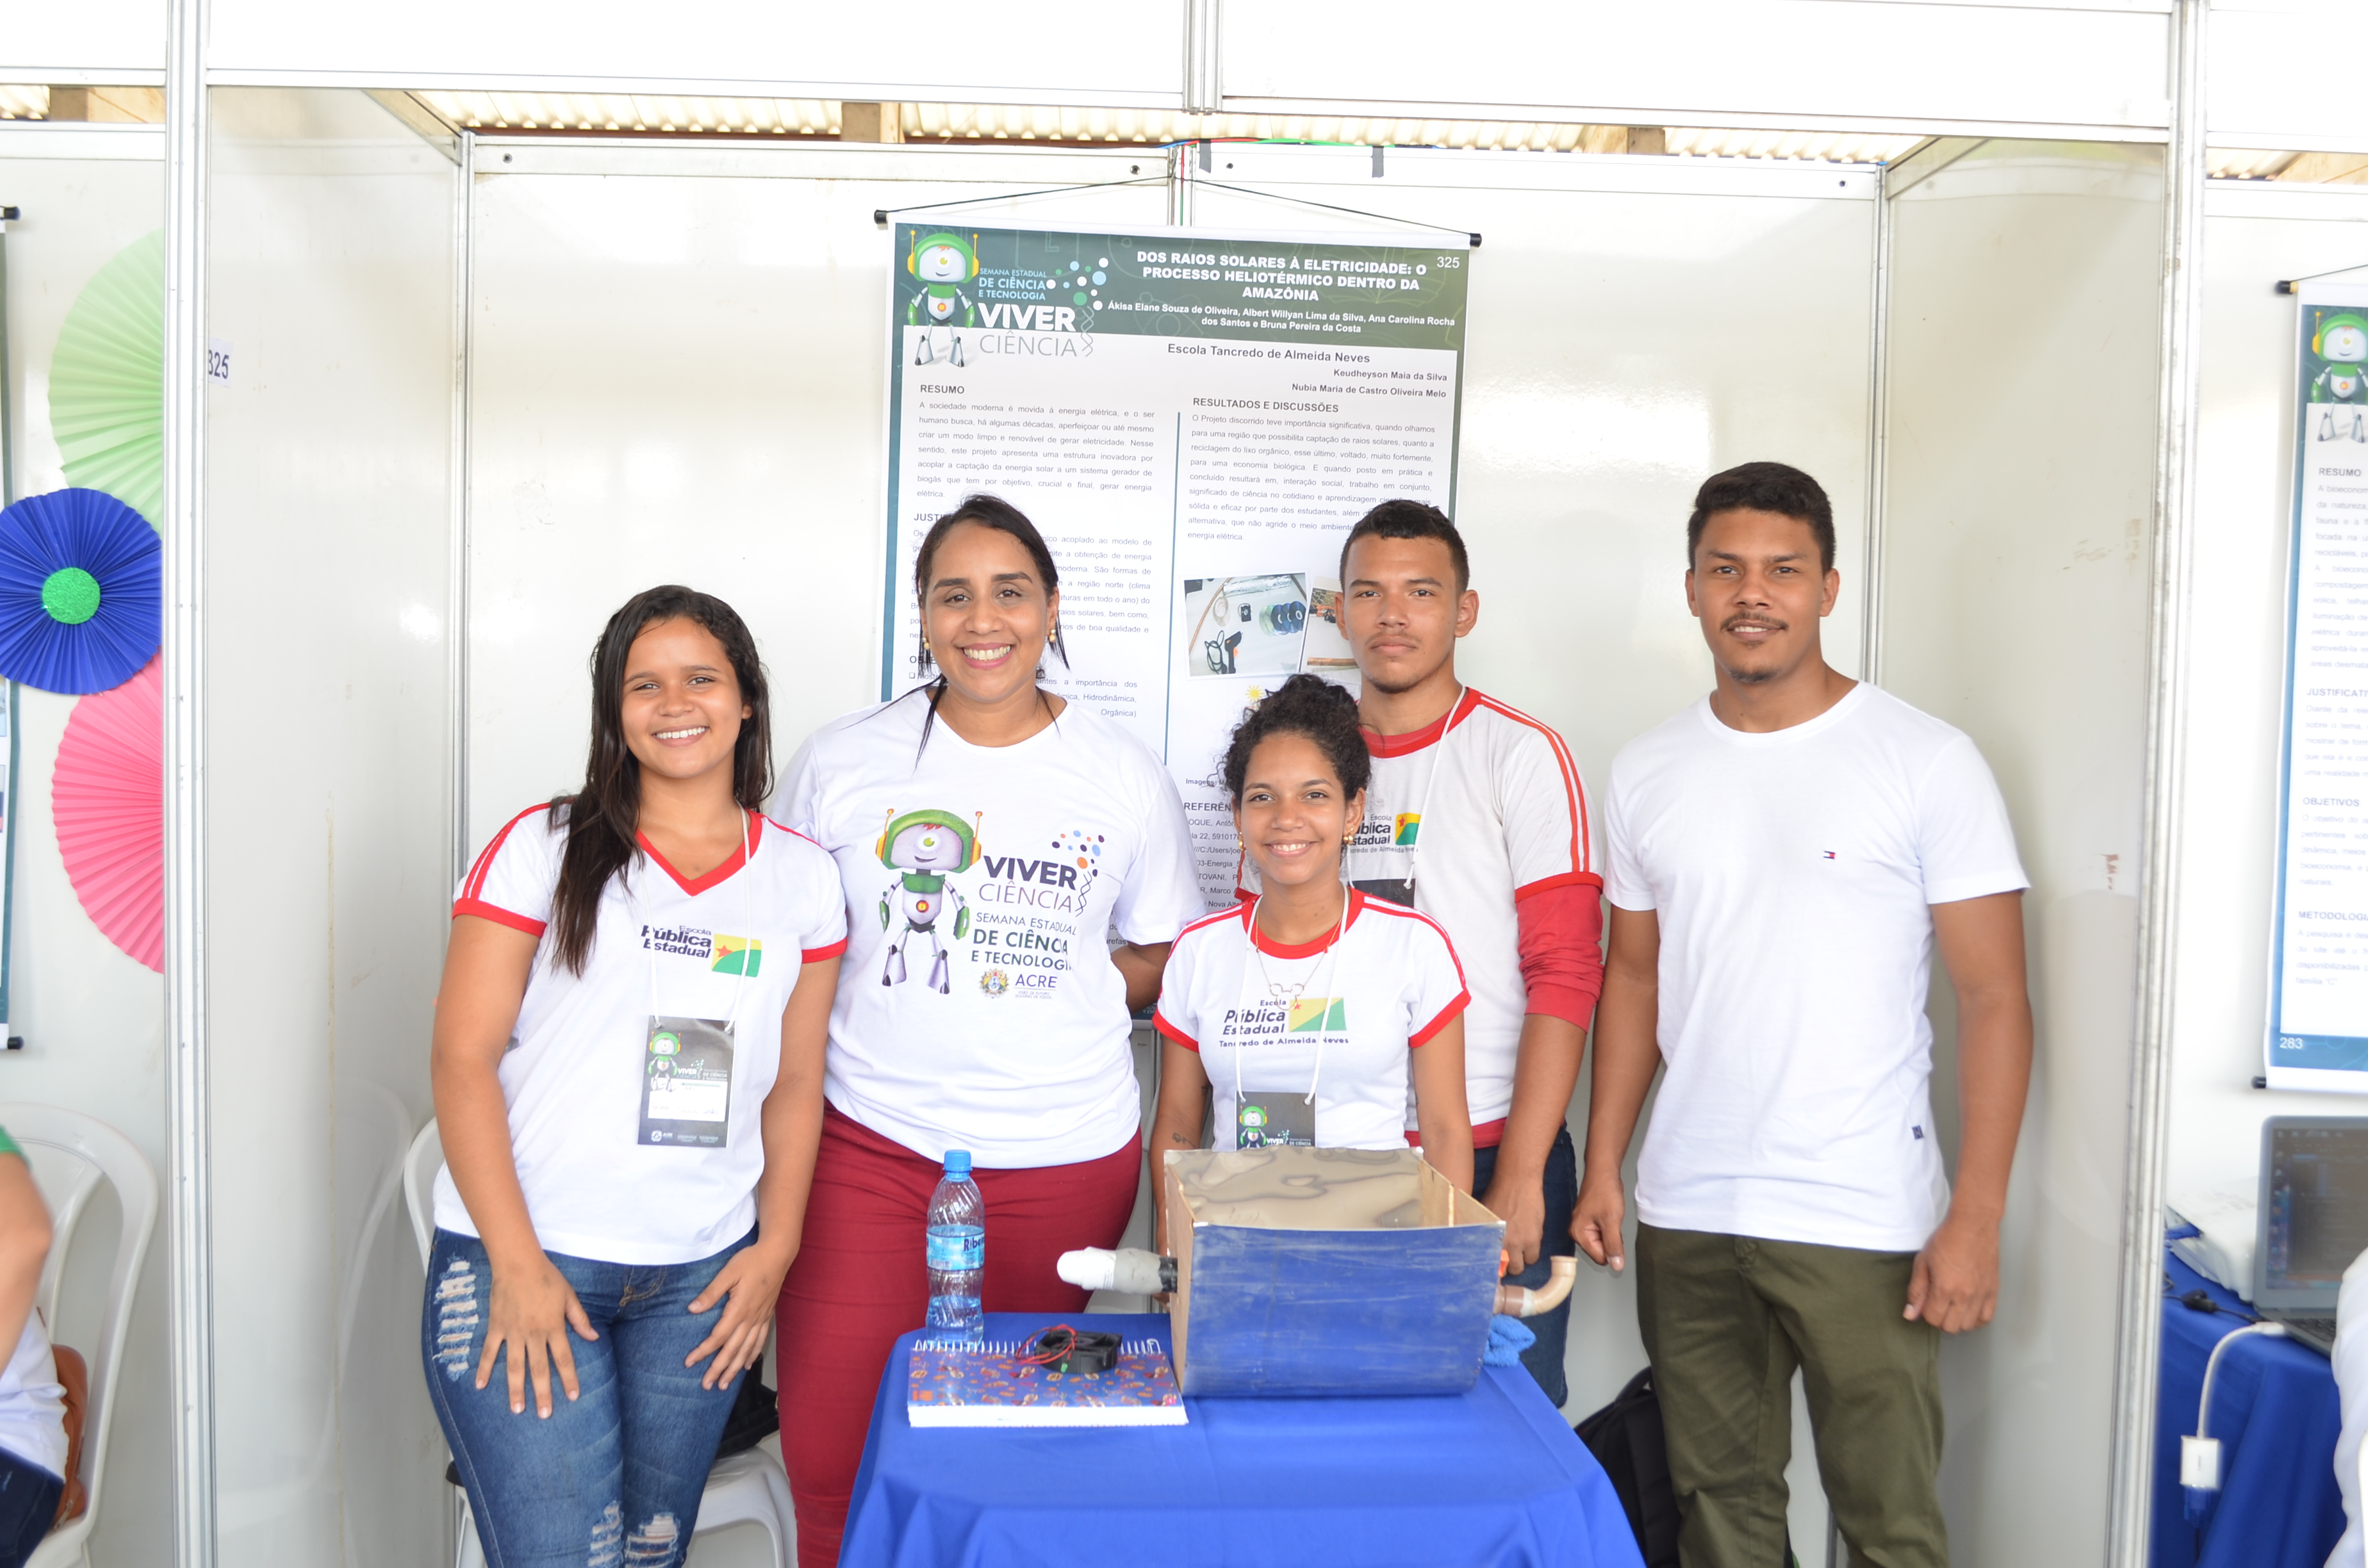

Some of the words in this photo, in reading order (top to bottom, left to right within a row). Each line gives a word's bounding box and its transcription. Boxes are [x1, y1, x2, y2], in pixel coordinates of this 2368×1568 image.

[1137, 250, 1167, 263] DOS
[1171, 252, 1215, 266] RAIOS
[1219, 254, 1286, 269] SOLARES
[1289, 256, 1300, 270] À
[1304, 259, 1411, 275] ELETRICIDADE:
[1415, 264, 1427, 275] O
[1436, 256, 1460, 268] 325
[1012, 270, 1047, 278] ESTADUAL
[1142, 266, 1221, 281] PROCESSO
[1224, 270, 1333, 286] HELIOTÉRMICO
[1337, 275, 1396, 290] DENTRO
[1400, 279, 1420, 290] DA
[979, 277, 994, 287] DE
[998, 277, 1046, 290] CIÊNCIA
[986, 290, 1046, 300] TECNOLOGIA
[1242, 286, 1319, 301] AMAZÔNIA
[978, 302, 1076, 332] VIVER
[1108, 300, 1133, 311] Ákisa
[1135, 302, 1160, 312] Elane
[1162, 304, 1189, 313] Souza
[1191, 305, 1203, 314] de
[1204, 306, 1240, 317] Oliveira,
[1242, 307, 1269, 318] Albert
[1270, 309, 1304, 321] Willyan
[1305, 311, 1327, 320] Lima
[1329, 312, 1340, 321] da
[1342, 313, 1367, 323] Silva,
[1368, 314, 1386, 323] Ana
[1388, 314, 1425, 325] Carolina
[1427, 316, 1455, 326] Rocha
[1201, 316, 1218, 326] dos
[1220, 317, 1251, 327] Santos
[1260, 320, 1287, 329] Bruna
[1289, 321, 1320, 331] Pereira
[1322, 323, 1333, 332] da
[1335, 323, 1361, 333] Costa
[980, 330, 1077, 357] CIÊNCIA
[1168, 343, 1206, 355] Escola
[1210, 345, 1264, 358] Tancredo
[1267, 348, 1281, 359] de
[1284, 349, 1331, 361] Almeida
[1335, 352, 1370, 363] Neves
[208, 349, 229, 379] 325
[1333, 368, 1388, 380] Keudheyson
[1390, 371, 1411, 380] Maia
[1413, 372, 1424, 380] da
[1426, 372, 1447, 381] Silva
[920, 384, 965, 395] RESUMO
[1292, 382, 1317, 392] Nubia
[1319, 384, 1344, 393] Maria
[1345, 386, 1356, 394] de
[1358, 386, 1388, 395] Castro
[1390, 388, 1423, 396] Oliveira
[1426, 389, 1447, 398] Melo
[929, 402, 967, 411] sociedade
[1017, 405, 1045, 414] movida
[1058, 408, 1086, 417] energia
[1090, 408, 1119, 418] elétrica,
[1193, 397, 1261, 409] RESULTADOS
[1263, 400, 1270, 410] E
[1272, 402, 1339, 413] DISCUSSÕES
[919, 416, 949, 425] humano
[950, 417, 975, 426] busca,
[989, 419, 1021, 429] algumas
[1022, 420, 1056, 430] décadas,
[1058, 422, 1100, 432] aperfeiçoar
[1201, 414, 1227, 425] Projeto
[1228, 416, 1265, 425] discorrido
[1284, 419, 1327, 429] importância
[1328, 421, 1373, 431] significativa,
[1375, 424, 1402, 432] quando
[1404, 425, 1436, 433] olhamos
[2319, 468, 2362, 477] RESUMO
[2327, 486, 2368, 494] bioeconom
[1083, 693, 1137, 703] Hidrodinâmica,
[1100, 708, 1137, 718] Orgânica)
[1184, 801, 1231, 812] REFERÊN
[2303, 797, 2360, 807] OBJETIVOS
[1357, 822, 1391, 835] blica
[1351, 835, 1390, 845] stadual
[983, 856, 1077, 890] VIVER
[979, 880, 1071, 913] CIÊNCIA
[679, 925, 711, 935] Escola
[976, 912, 1026, 926] SEMANA
[1030, 918, 1076, 935] ESTADUAL
[641, 925, 712, 947] Pública
[973, 929, 998, 945] DE
[643, 938, 711, 958] Estadual
[971, 950, 979, 961] E
[1015, 974, 1058, 988] ACRE
[1222, 1024, 1285, 1035] Estadual
[2279, 1037, 2303, 1049] 283
